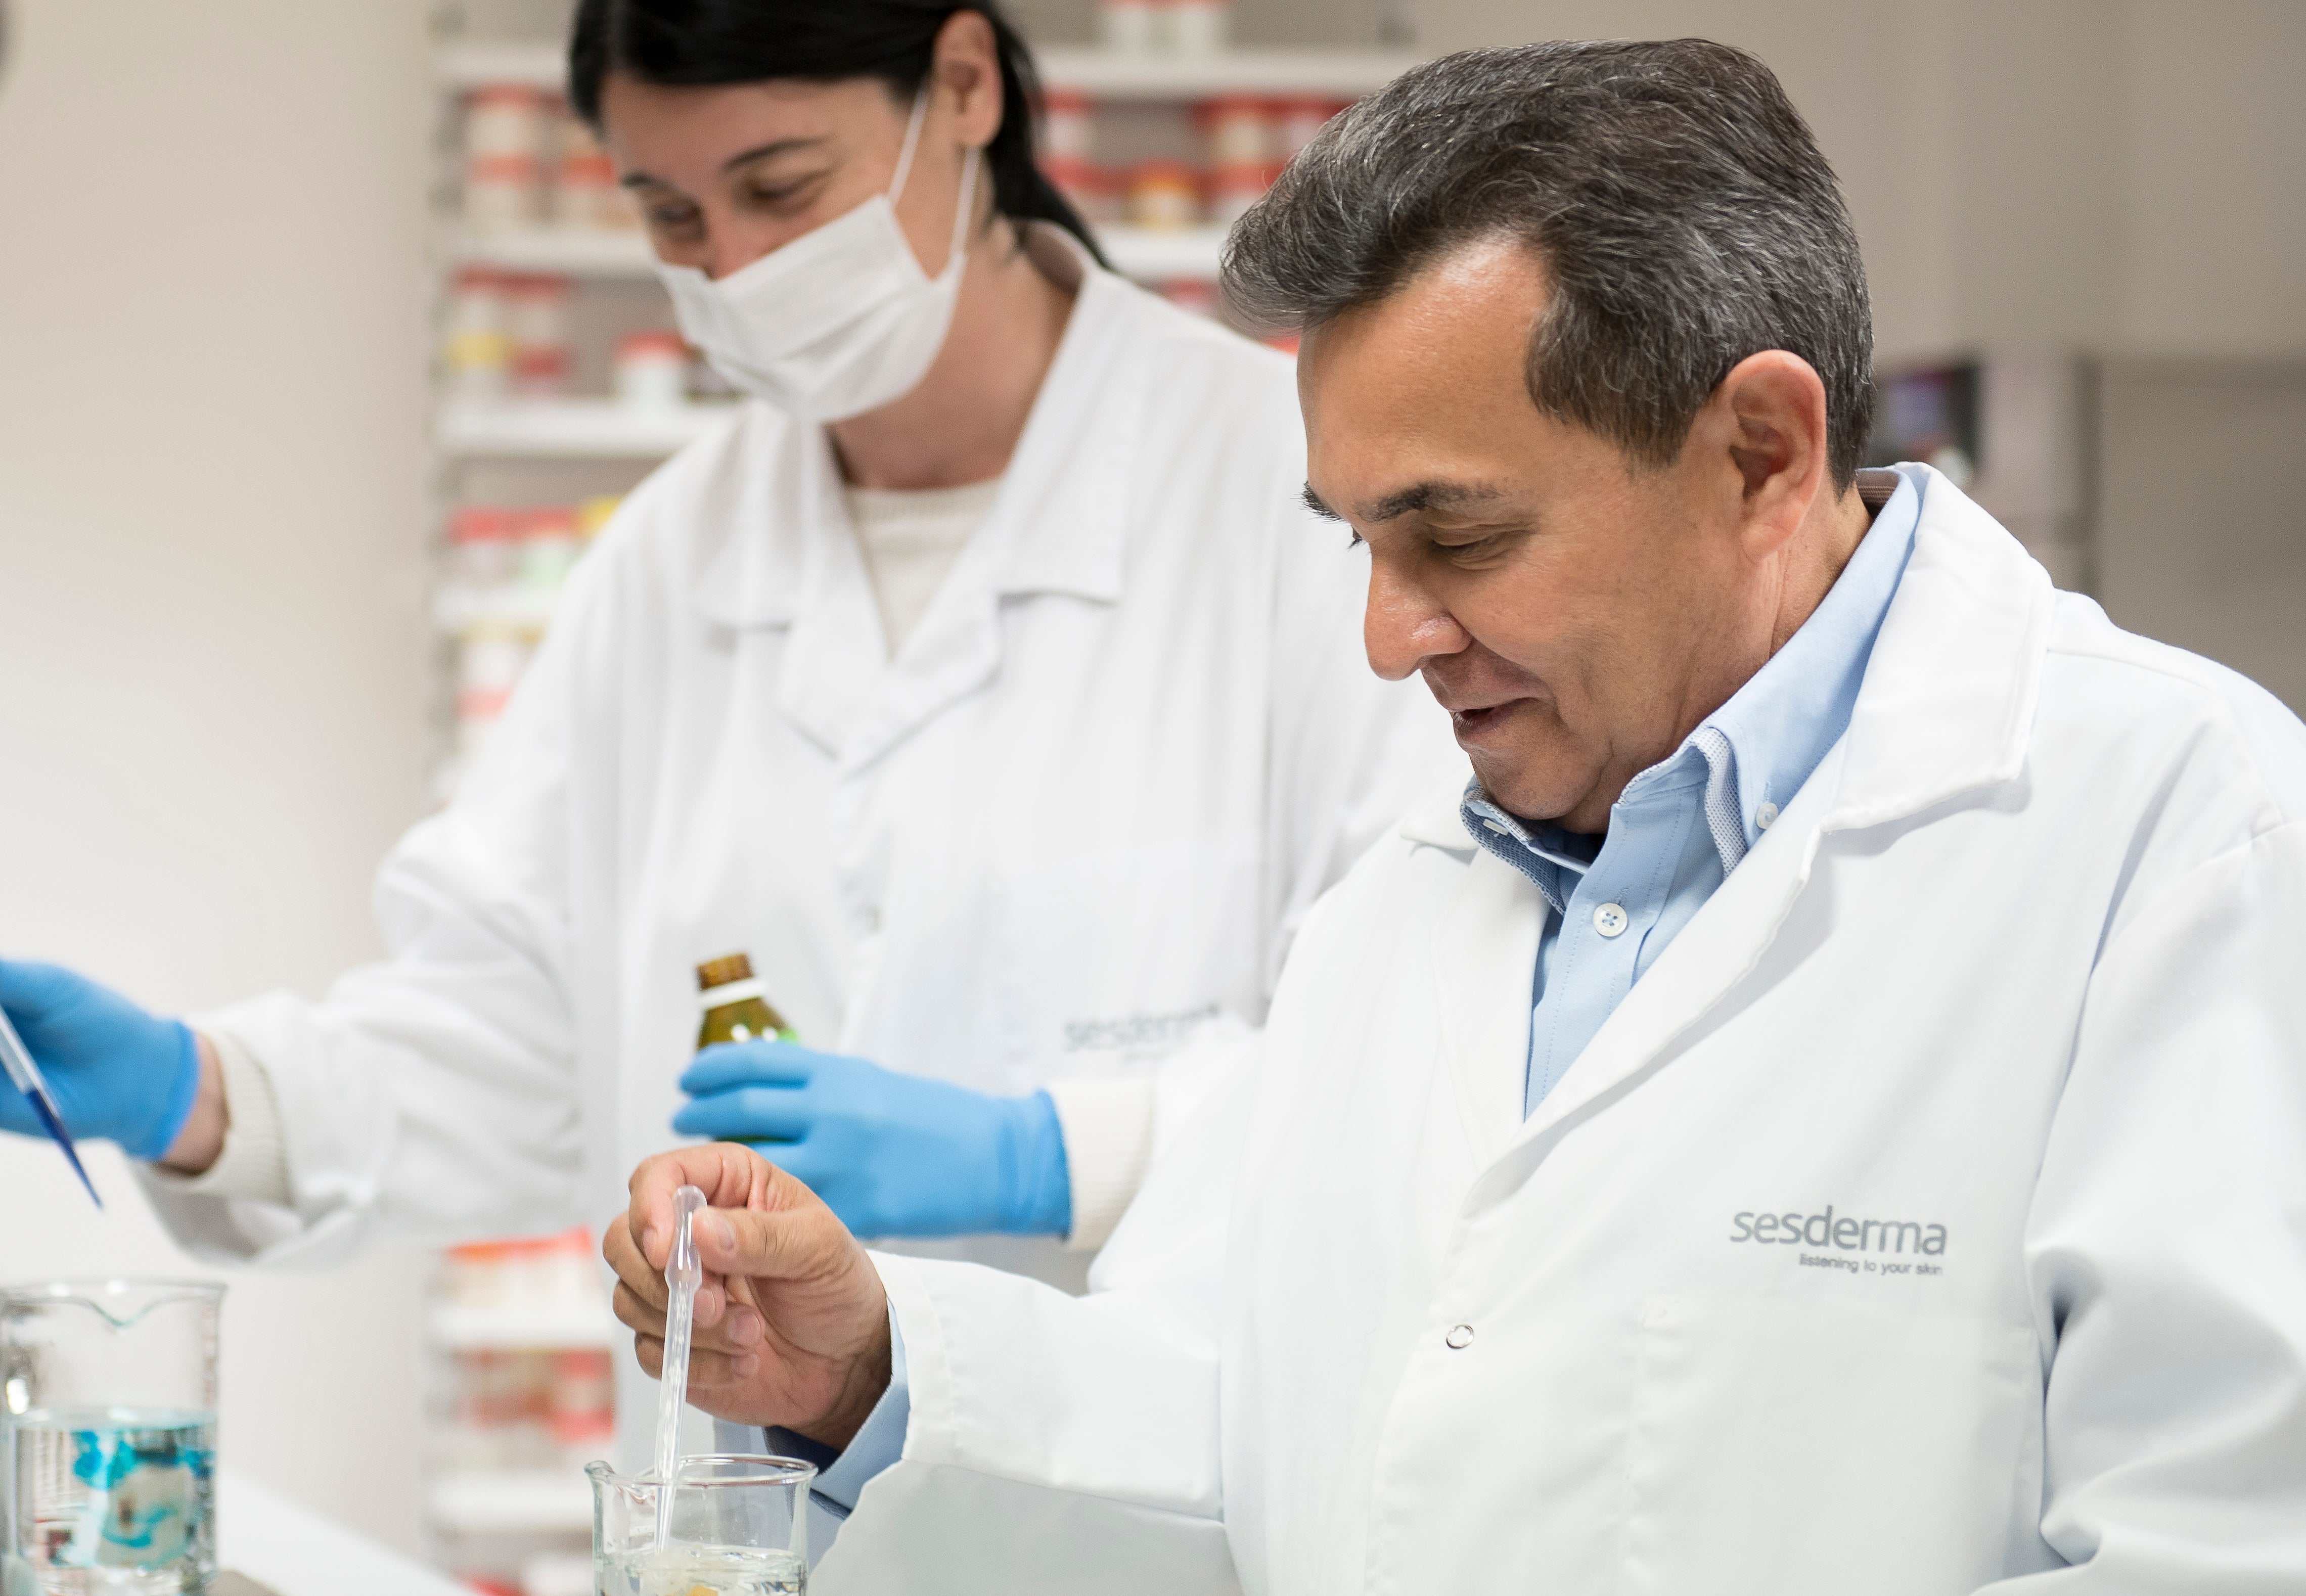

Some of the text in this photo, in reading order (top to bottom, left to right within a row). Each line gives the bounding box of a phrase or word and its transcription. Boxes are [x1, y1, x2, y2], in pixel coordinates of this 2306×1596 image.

[1730, 1204, 1948, 1257] sesderma
[1799, 1253, 1942, 1275] listening to your skin
